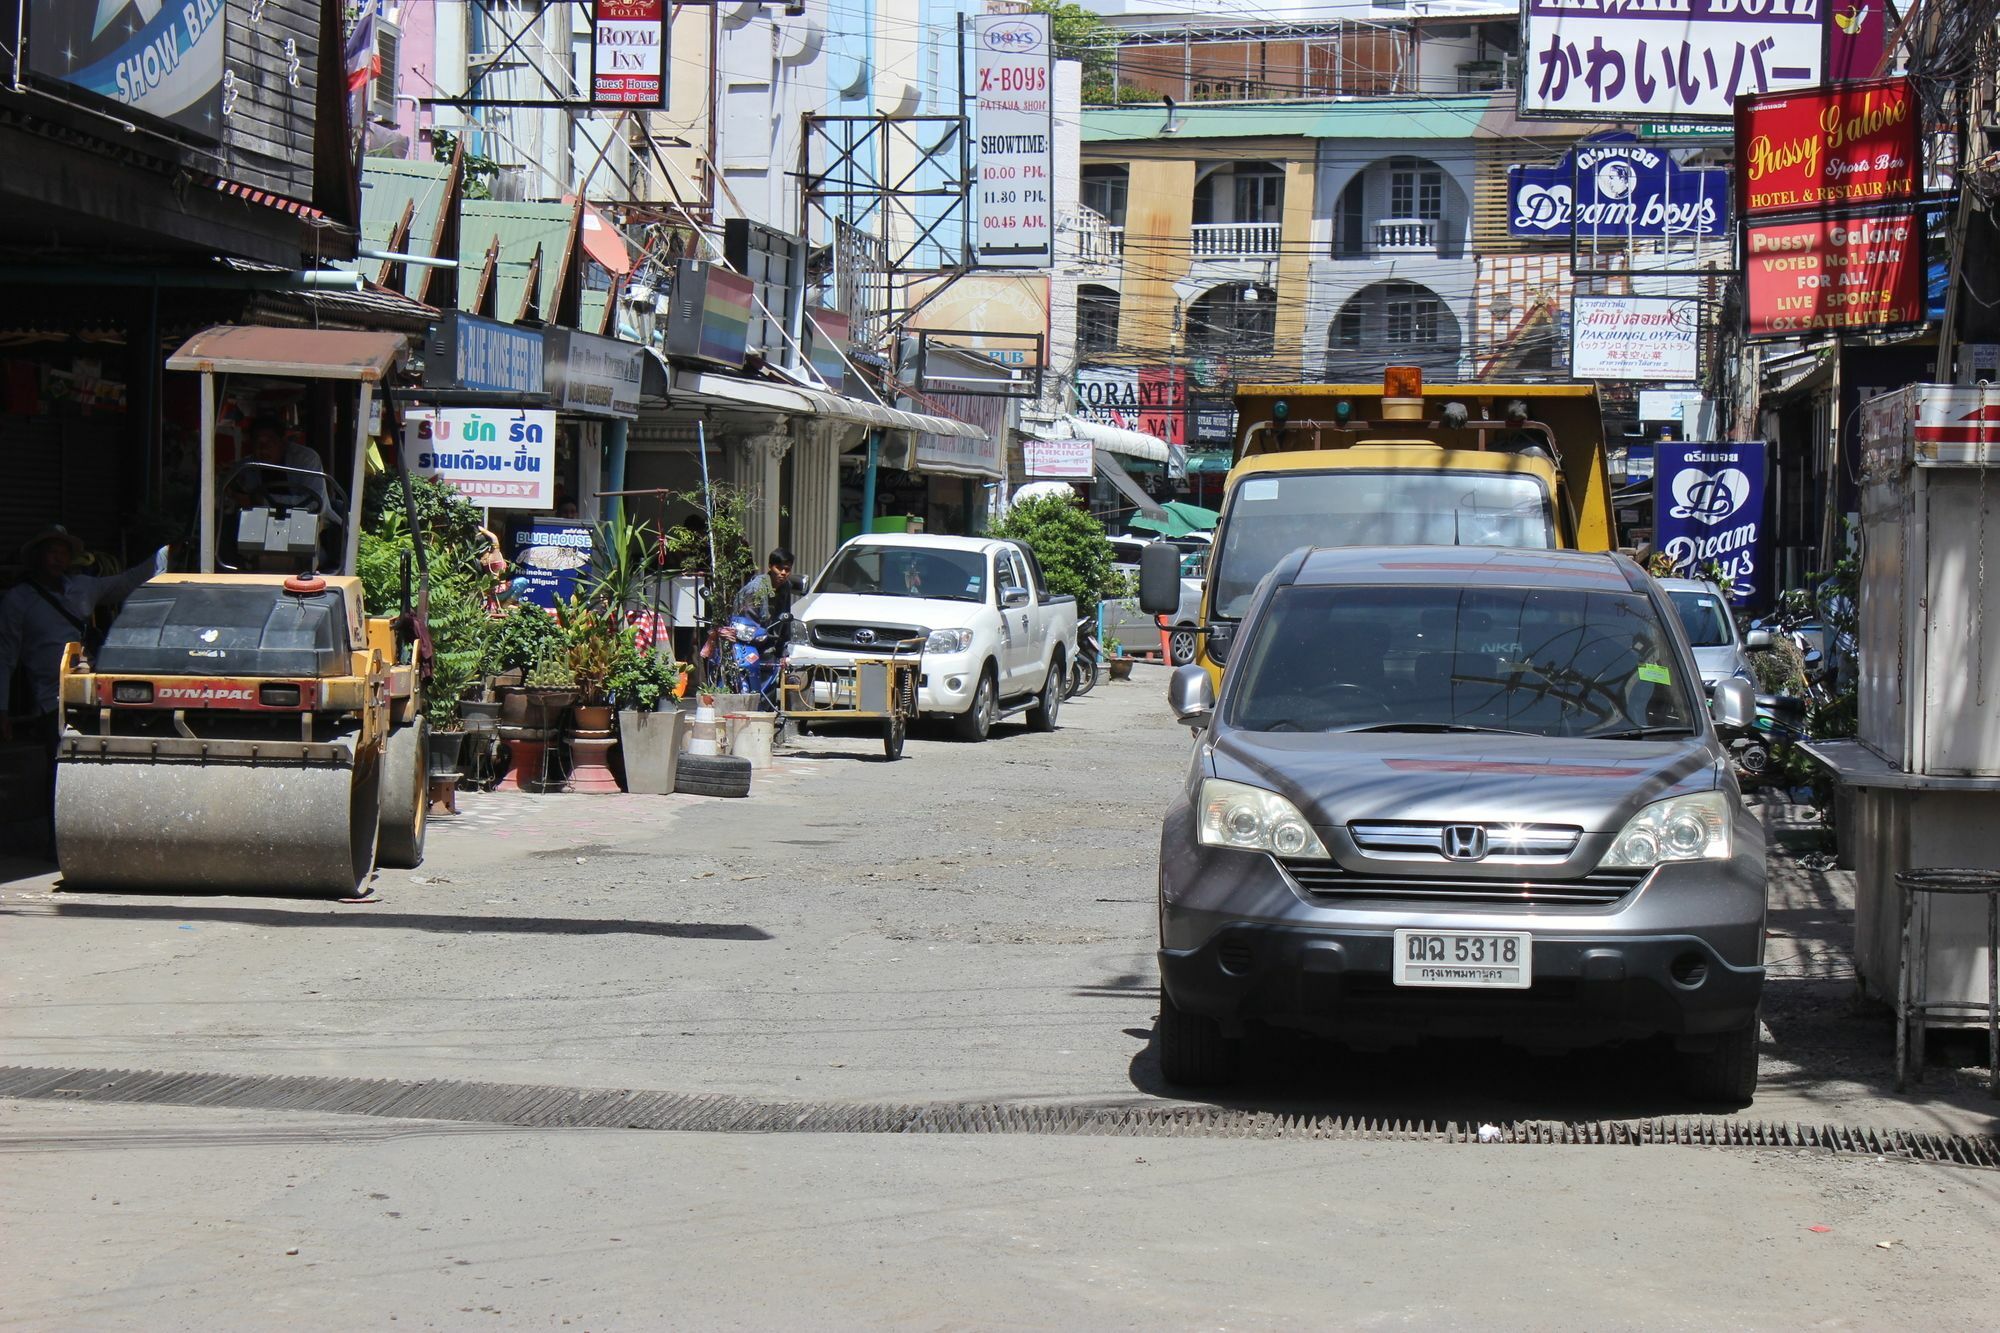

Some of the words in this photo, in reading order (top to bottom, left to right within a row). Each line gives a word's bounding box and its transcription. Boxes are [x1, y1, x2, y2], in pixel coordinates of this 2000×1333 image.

[610, 8, 646, 17] ROYAL
[597, 27, 659, 46] ROYAL
[116, 22, 179, 105] SHOW
[183, 0, 221, 47] BA
[611, 50, 646, 70] INN
[980, 67, 1046, 91] X-BOYS
[1538, 33, 1811, 106] かわいいバー
[595, 78, 624, 90] Guest
[626, 79, 659, 91] House
[623, 92, 637, 101] for
[639, 92, 659, 102] Rent
[980, 100, 1020, 111] PATTAYA
[981, 135, 1048, 154] SHOWTIME:
[1747, 134, 1821, 181] Pussy
[1820, 91, 1907, 148] Galore
[984, 167, 1016, 179] 10.00
[1825, 158, 1870, 180] Sports
[1874, 154, 1905, 171] Bar
[984, 190, 1016, 203] 11.30
[1751, 191, 1799, 208] HOTEL
[1803, 189, 1814, 202] &
[1816, 178, 1912, 201] RESTAURANT
[983, 215, 1017, 229] 00.45
[1515, 193, 1639, 230] Dream
[1639, 194, 1717, 234] boys
[1752, 233, 1816, 253] Pussy
[1830, 223, 1908, 247] Galore
[1762, 256, 1819, 273] VOTED
[1797, 274, 1831, 289] FOR
[1838, 272, 1868, 287] ALL
[1777, 295, 1813, 311] LIVE
[1826, 290, 1892, 307] SPORTS
[467, 326, 486, 384] BLUE
[487, 329, 510, 388] HOUSE
[511, 335, 529, 392] BEER
[989, 351, 1024, 364] PUB
[418, 414, 451, 440] รับ
[462, 414, 496, 442] ซัก
[509, 416, 543, 443] รีด
[1028, 449, 1085, 457] PARKING
[516, 531, 549, 545] BLUE
[549, 533, 593, 547] HOUSE
[1665, 522, 1758, 571] Dream
[516, 569, 553, 577] Heineken
[531, 578, 558, 586] Miguel
[158, 688, 254, 700] DYNAPAC
[1455, 938, 1517, 963] 5318
